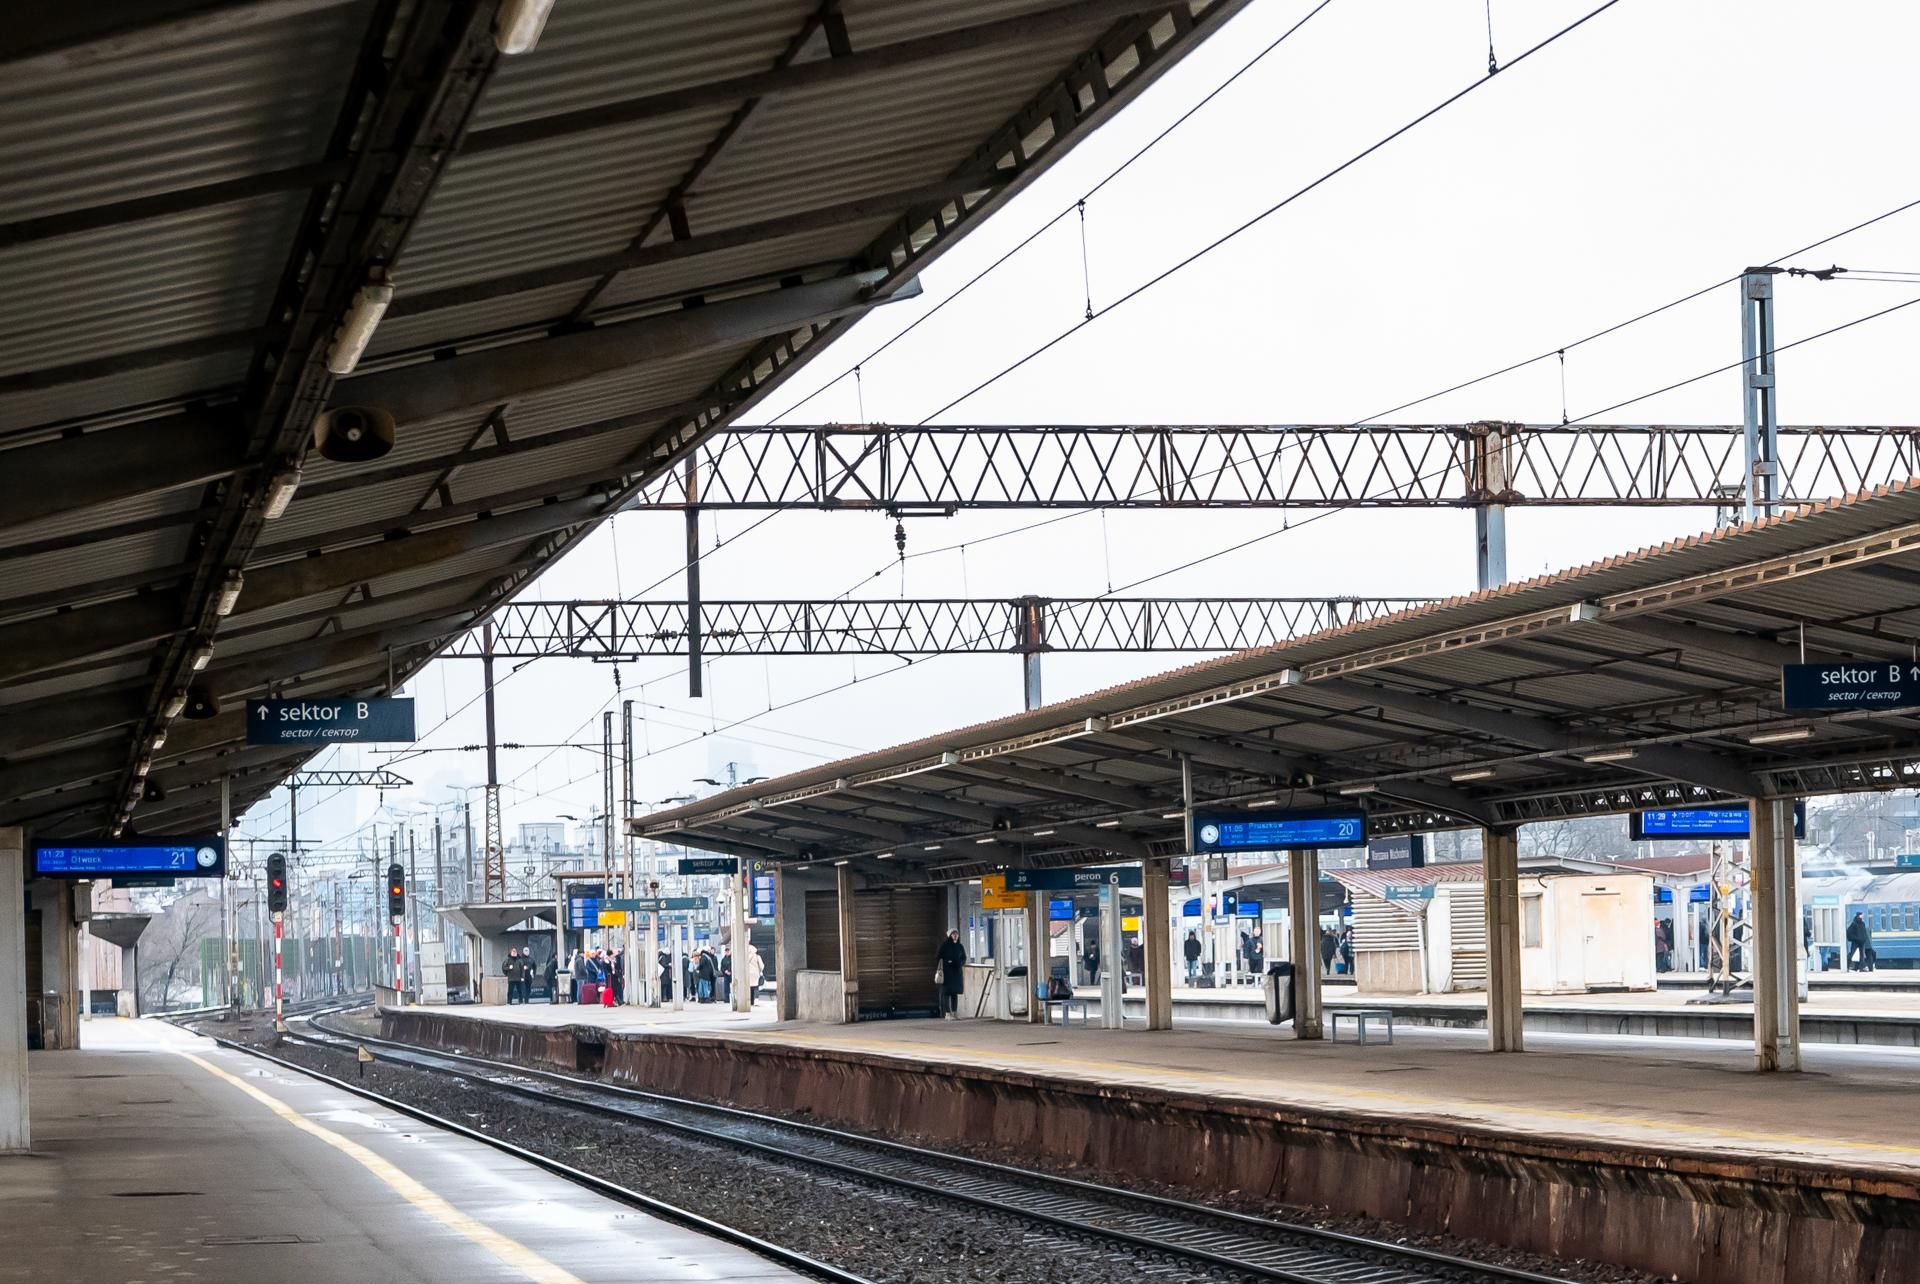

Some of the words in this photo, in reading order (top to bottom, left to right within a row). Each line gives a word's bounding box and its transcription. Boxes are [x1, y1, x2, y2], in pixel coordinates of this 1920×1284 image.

[1821, 666, 1877, 684] sektor
[1889, 665, 1901, 683] B
[1828, 691, 1859, 701] sector
[1860, 690, 1866, 700] /
[1867, 691, 1901, 701] сектор
[279, 702, 341, 721] sektor
[356, 702, 369, 720] B
[280, 728, 313, 738] sector
[314, 727, 322, 737] /
[322, 727, 359, 738] сектор
[1338, 823, 1354, 837] 20
[43, 850, 65, 858] 11:23
[171, 851, 186, 865] 21
[753, 860, 761, 871] 6
[1074, 872, 1101, 883] peron
[1109, 871, 1119, 885] 6
[659, 899, 667, 909] 6
